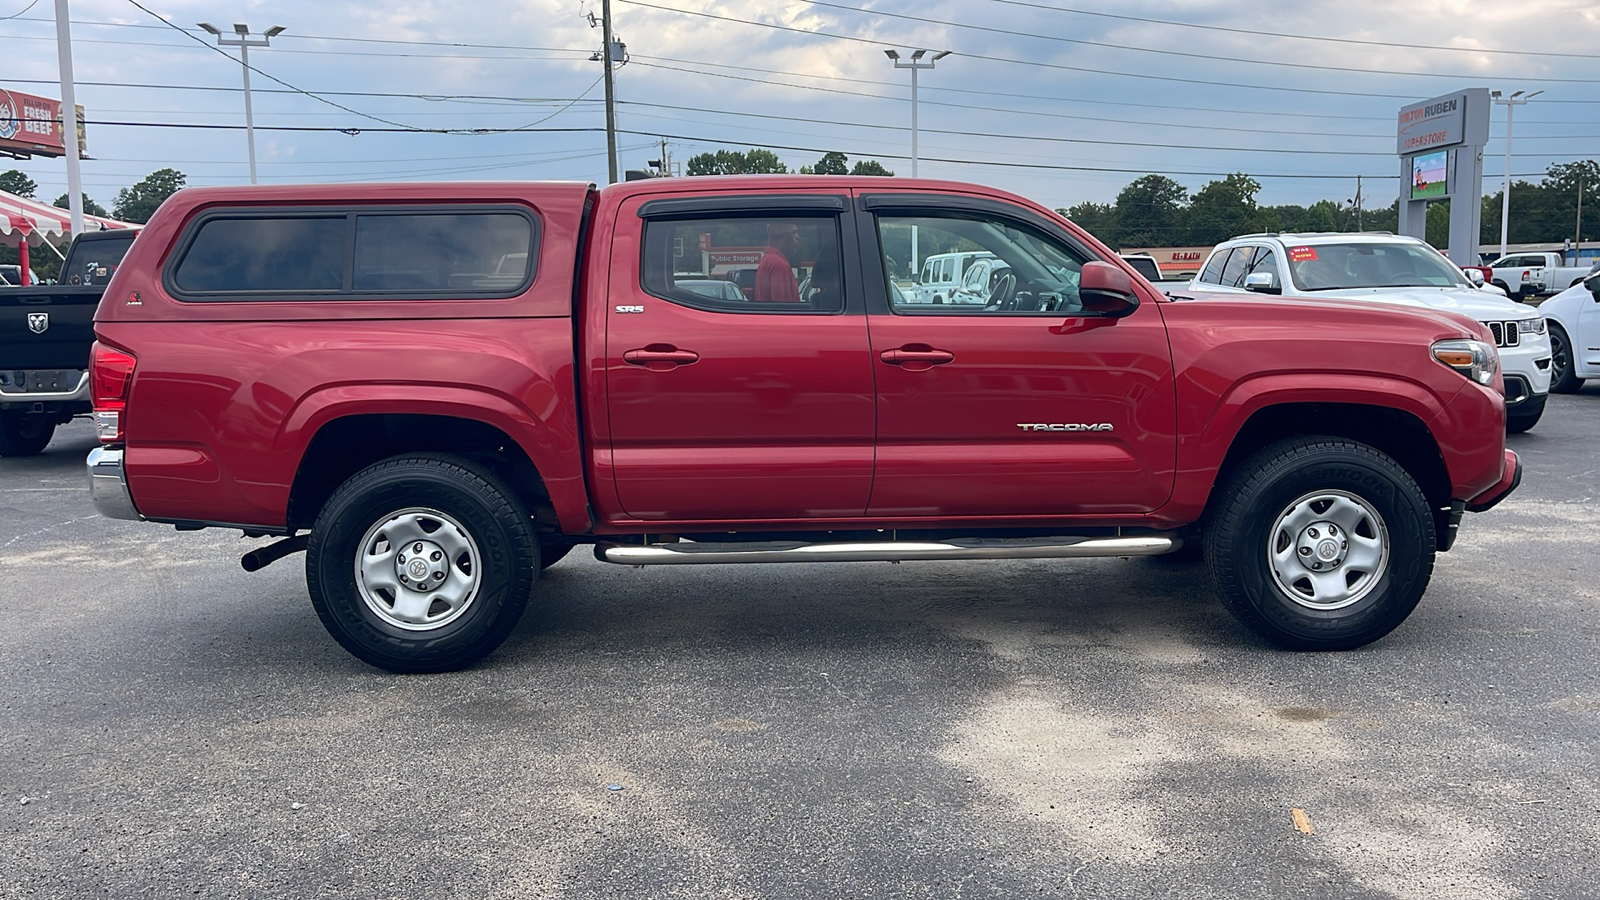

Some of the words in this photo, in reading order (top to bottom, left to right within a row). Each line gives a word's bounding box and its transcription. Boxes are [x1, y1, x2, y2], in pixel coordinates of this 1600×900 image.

[24, 99, 35, 107] FILL
[34, 100, 42, 108] UP
[42, 102, 51, 110] ON
[1399, 107, 1424, 124] MILTON
[1424, 99, 1457, 117] RUBEN
[24, 106, 52, 121] FRESH
[25, 118, 52, 135] BEEF
[1403, 130, 1448, 149] SUPERSTORE
[615, 305, 644, 313] SR5
[1016, 423, 1114, 431] TACOMA
